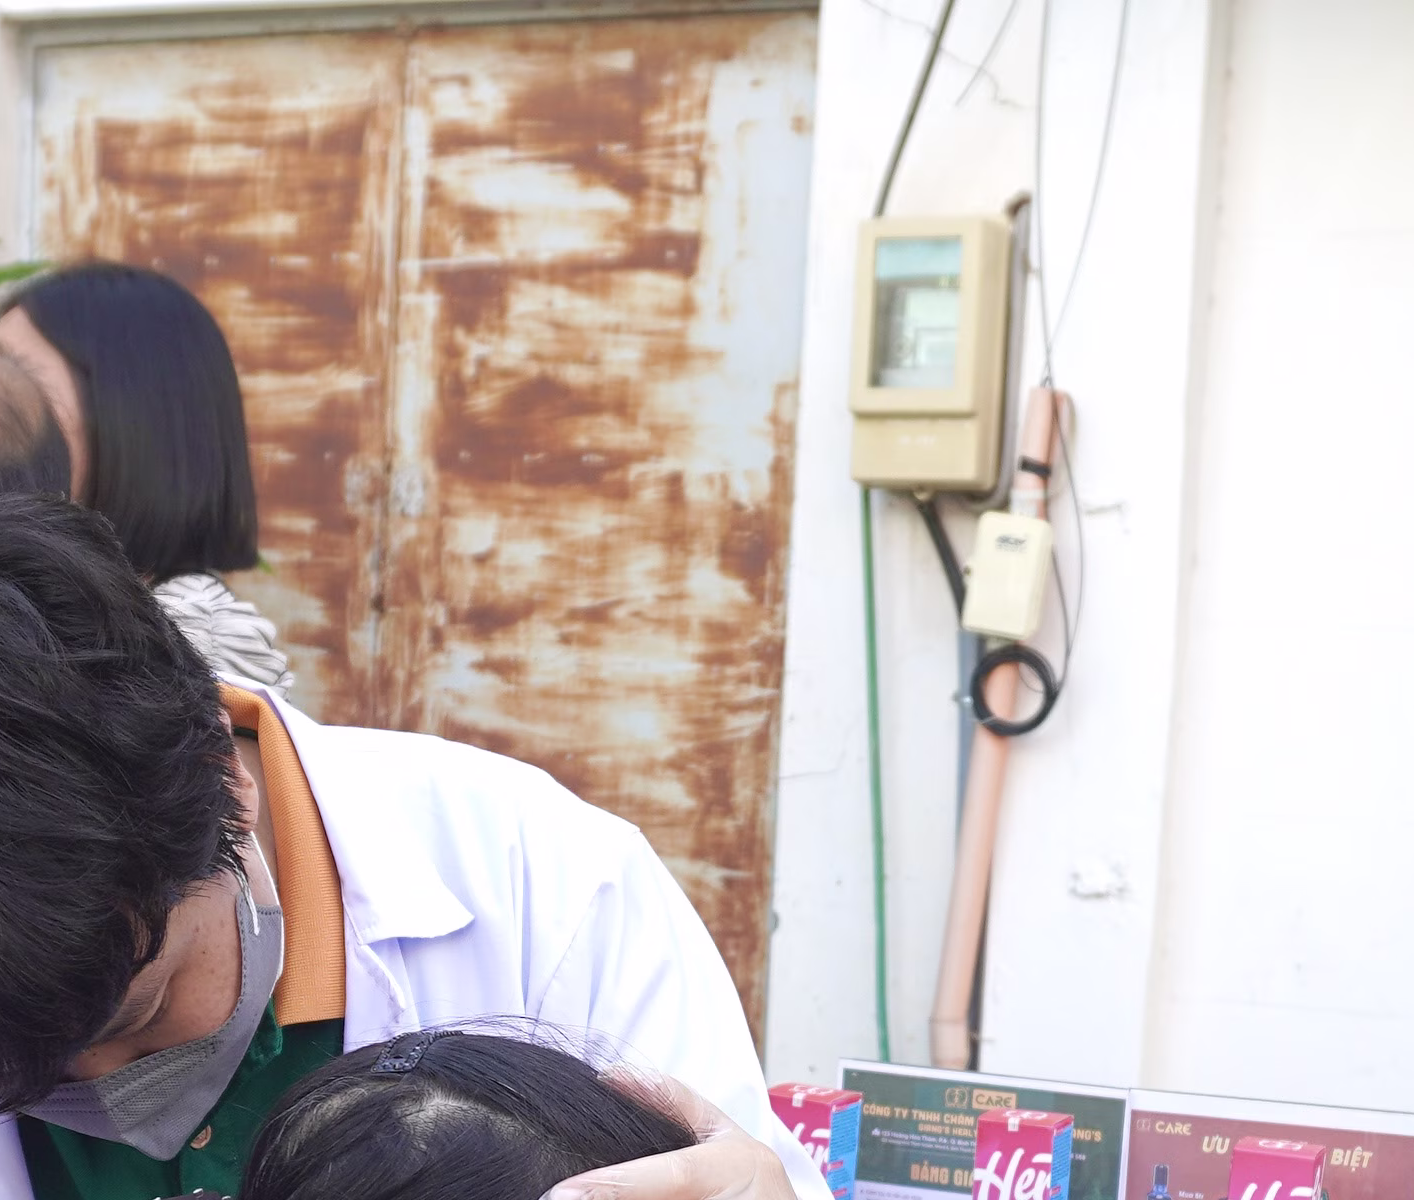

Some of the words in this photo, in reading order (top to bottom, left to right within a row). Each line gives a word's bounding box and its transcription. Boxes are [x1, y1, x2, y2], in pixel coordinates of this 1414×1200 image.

[975, 1095, 1012, 1107] CARE
[894, 1107, 907, 1118] TY
[913, 1110, 940, 1122] TNHH
[1155, 1121, 1192, 1136] CARE
[1330, 1146, 1373, 1172] BIỆT
